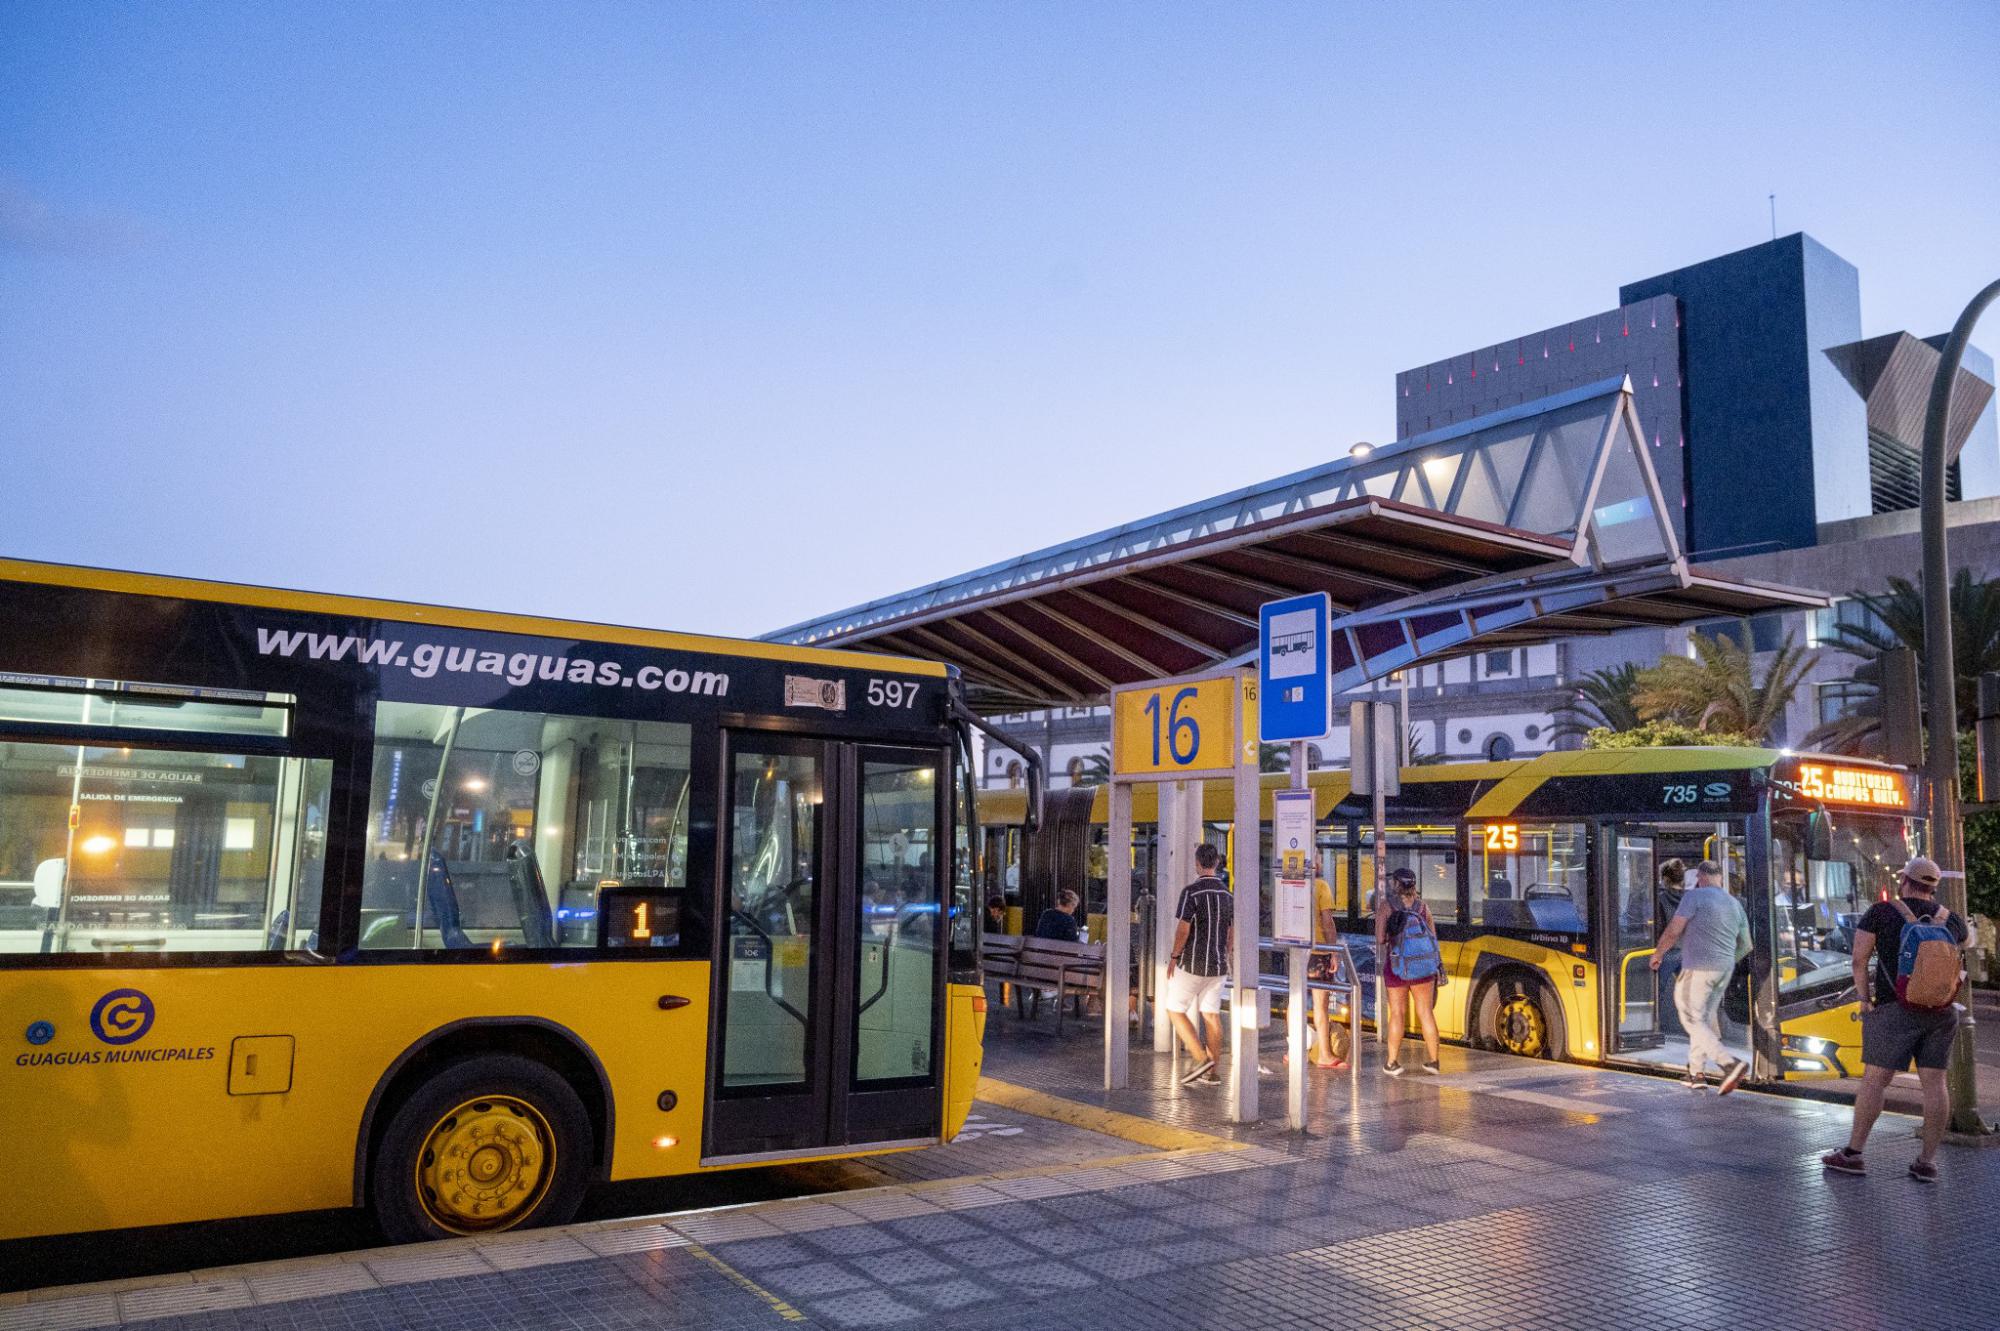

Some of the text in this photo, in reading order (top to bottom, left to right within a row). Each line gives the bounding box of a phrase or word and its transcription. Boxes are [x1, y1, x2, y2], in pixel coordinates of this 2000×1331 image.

[256, 626, 730, 697] www.guaguas.com
[867, 678, 921, 709] 597
[1243, 686, 1257, 701] 16
[1143, 687, 1200, 767] 16
[1662, 785, 1698, 804] 735
[1799, 767, 1824, 798] 25
[80, 793, 111, 801] SALIDA
[1486, 825, 1519, 850] 25
[633, 902, 650, 938] 1
[744, 949, 759, 958] 10€
[15, 1046, 216, 1067] GUAGUAS MUNICIPALES
